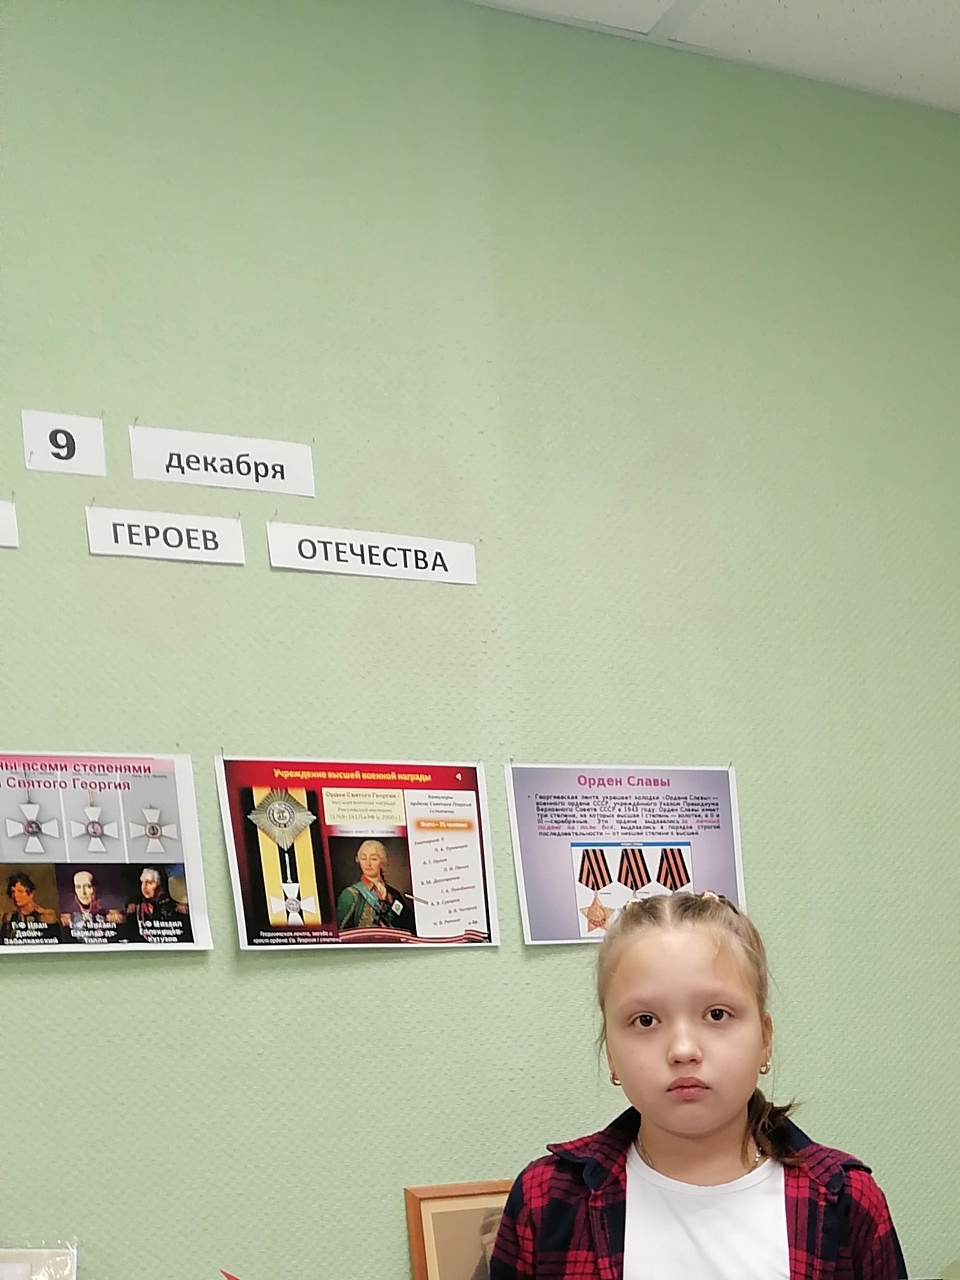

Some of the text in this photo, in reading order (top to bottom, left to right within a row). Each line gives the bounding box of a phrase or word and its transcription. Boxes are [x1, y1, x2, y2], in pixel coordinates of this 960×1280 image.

[48, 428, 286, 483] 9 декабря
[111, 522, 449, 573] ГЕРОЕВ ОТЕЧЕСТВА
[22, 762, 68, 772] всеми
[73, 762, 151, 774] степенями
[7, 776, 131, 792] Святого Георгия
[577, 775, 671, 788] Орден Славы
